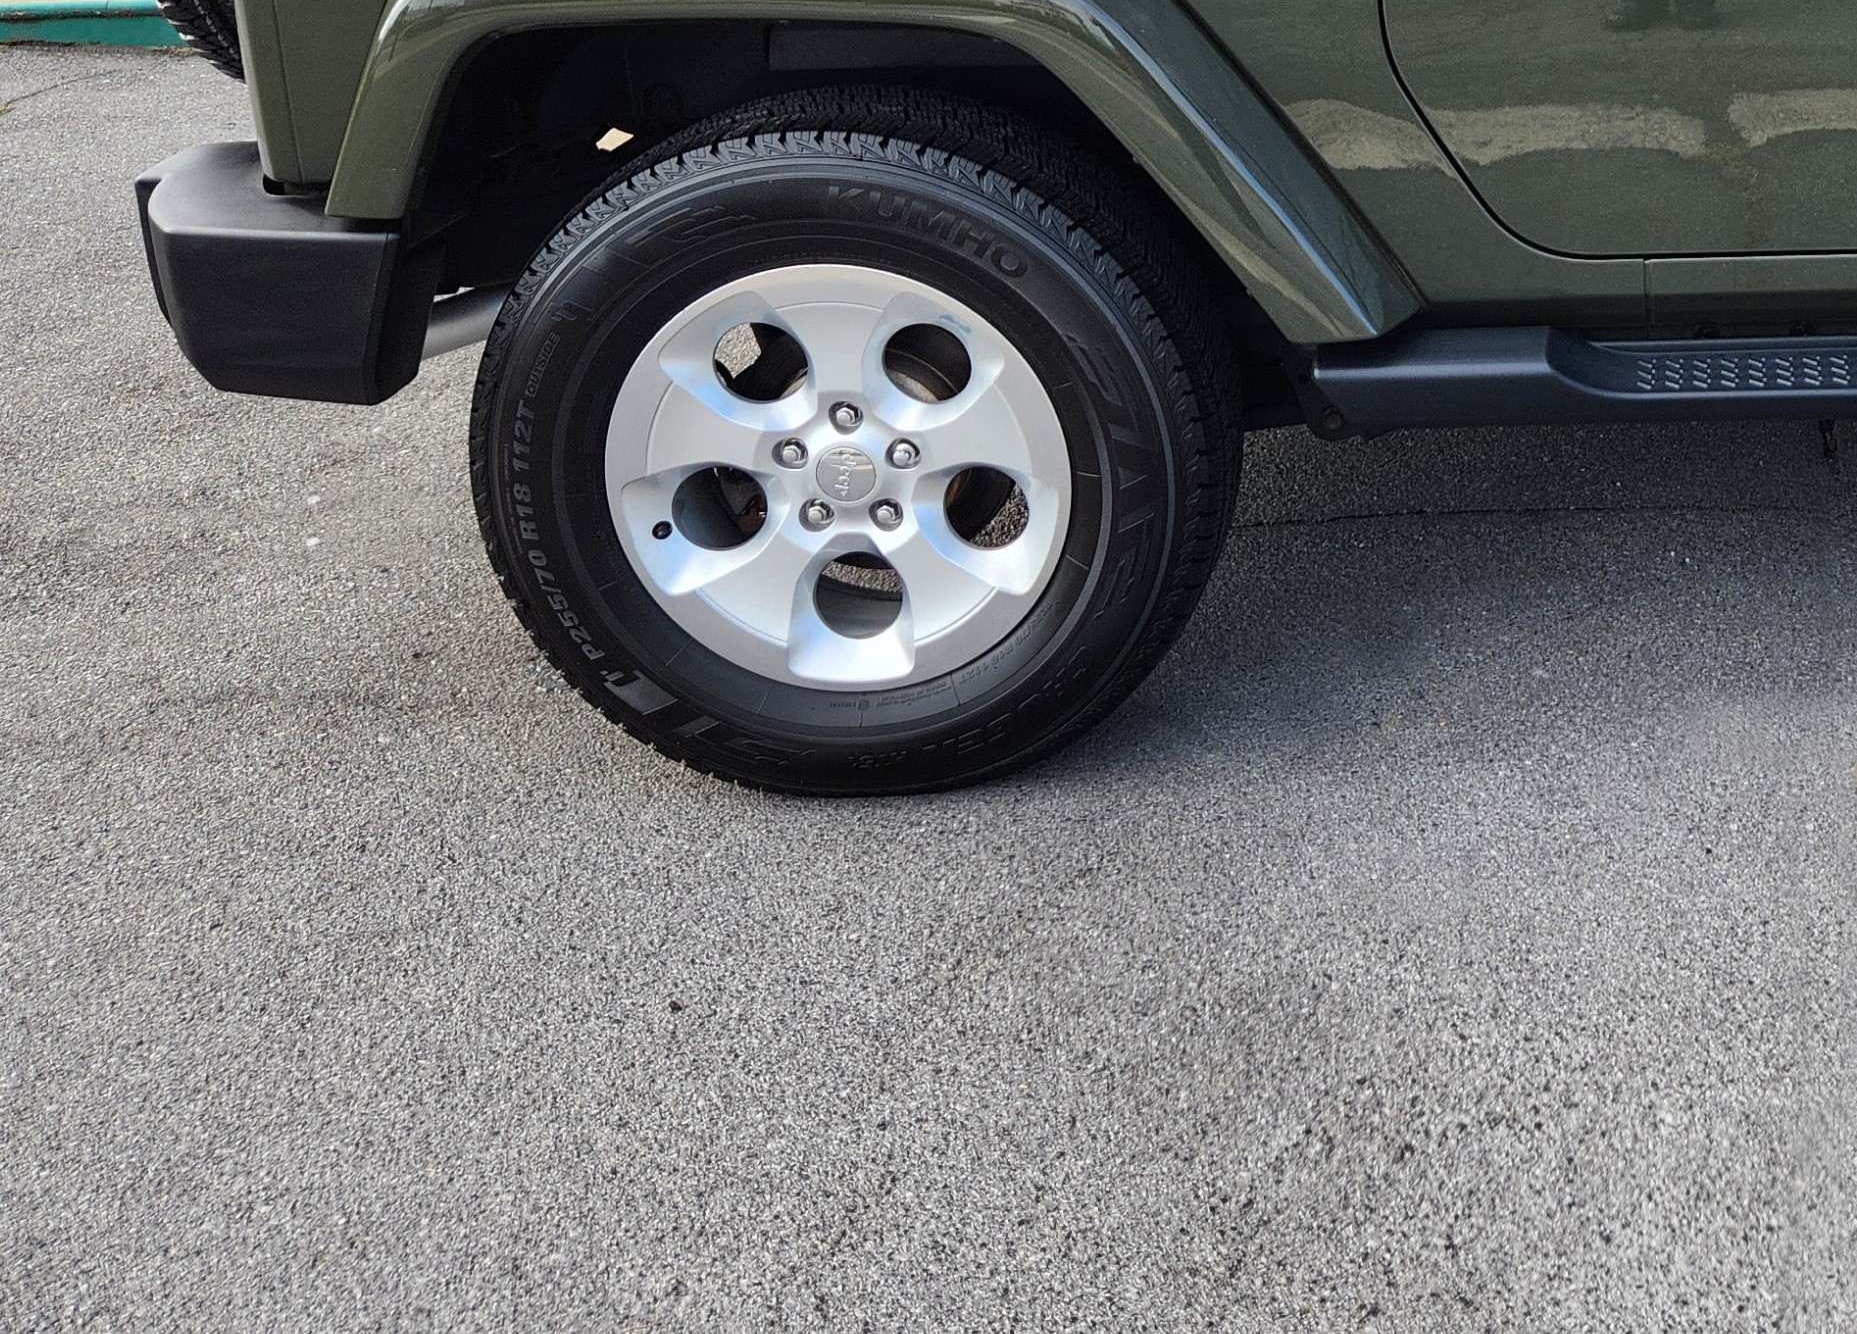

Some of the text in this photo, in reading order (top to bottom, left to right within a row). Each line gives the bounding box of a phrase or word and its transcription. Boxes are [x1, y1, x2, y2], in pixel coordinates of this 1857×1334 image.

[828, 185, 1029, 278] KUMHO
[525, 331, 561, 398] OUTSIDE
[512, 399, 537, 472] 112T
[513, 481, 540, 542] R18
[529, 546, 606, 662] P255/70
